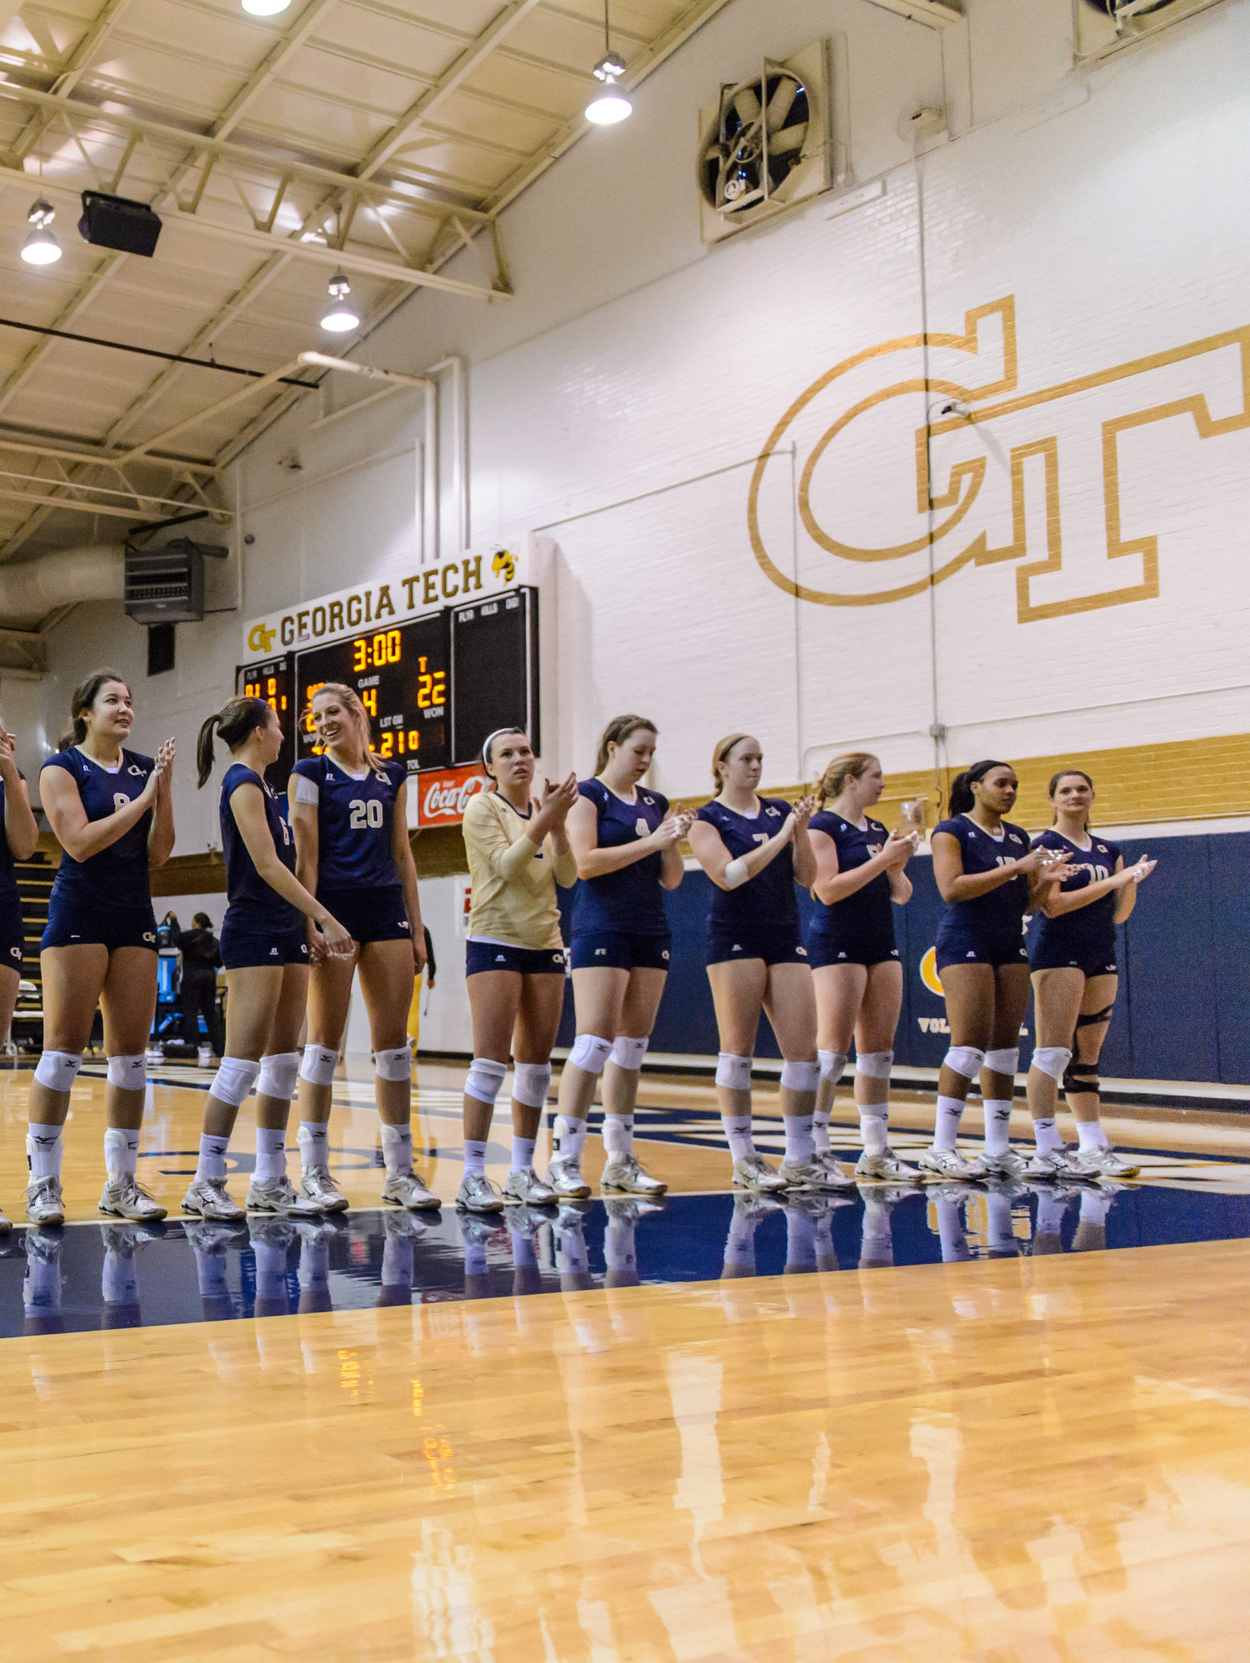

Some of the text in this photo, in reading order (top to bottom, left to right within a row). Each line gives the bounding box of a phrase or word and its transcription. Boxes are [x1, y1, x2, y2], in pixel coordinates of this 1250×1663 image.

[281, 585, 395, 646] GEORGIA
[402, 555, 482, 610] TECH
[353, 629, 401, 673] 3:00
[357, 675, 380, 689] GAME
[362, 688, 377, 717] 4
[423, 705, 445, 719] WON
[348, 799, 384, 830] 20
